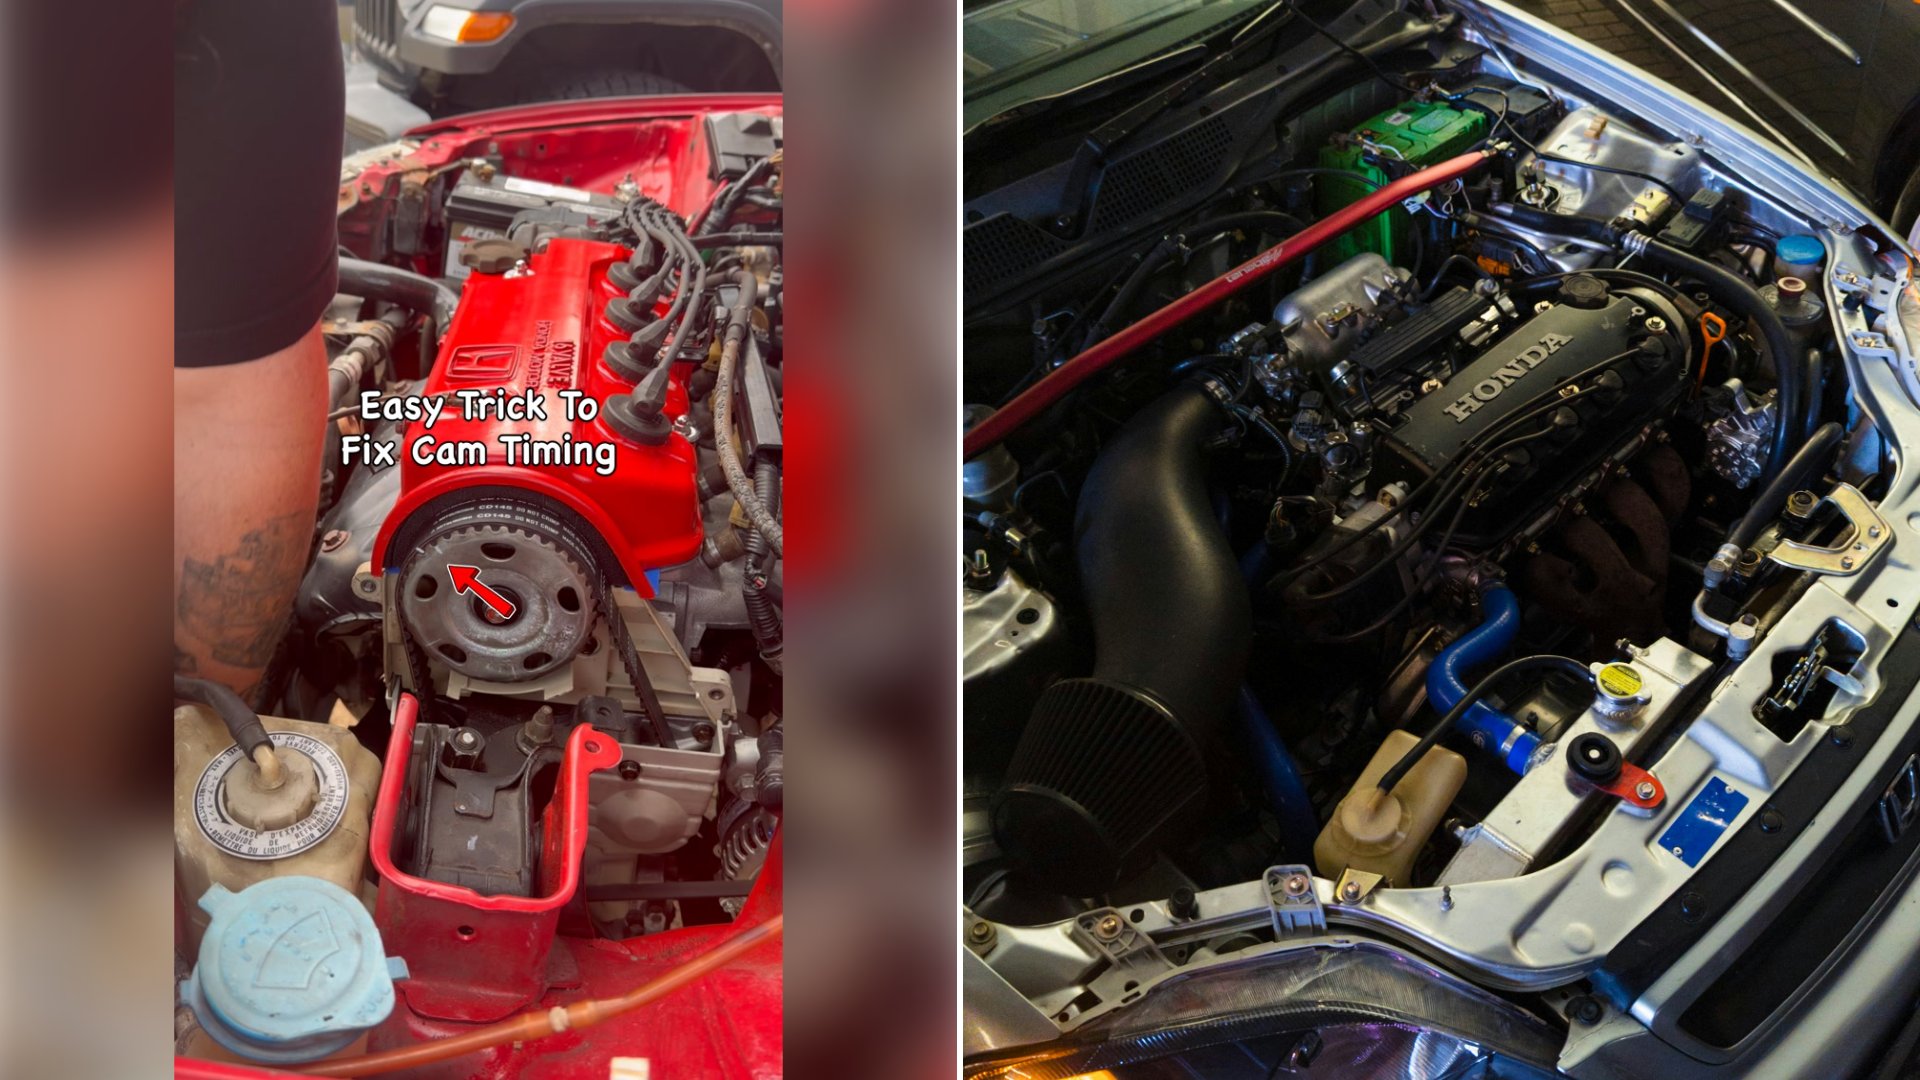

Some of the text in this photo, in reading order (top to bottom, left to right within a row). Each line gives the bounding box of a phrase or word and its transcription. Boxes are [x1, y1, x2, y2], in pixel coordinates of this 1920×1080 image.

[1443, 332, 1574, 424] HONDA
[284, 740, 316, 756] RESERVE
[211, 828, 242, 851] REMETTRE
[247, 846, 258, 854] DU
[297, 832, 316, 847] POUR
[224, 829, 254, 846] LIQUIDE
[268, 838, 279, 846] DE
[238, 827, 260, 839] VASE
